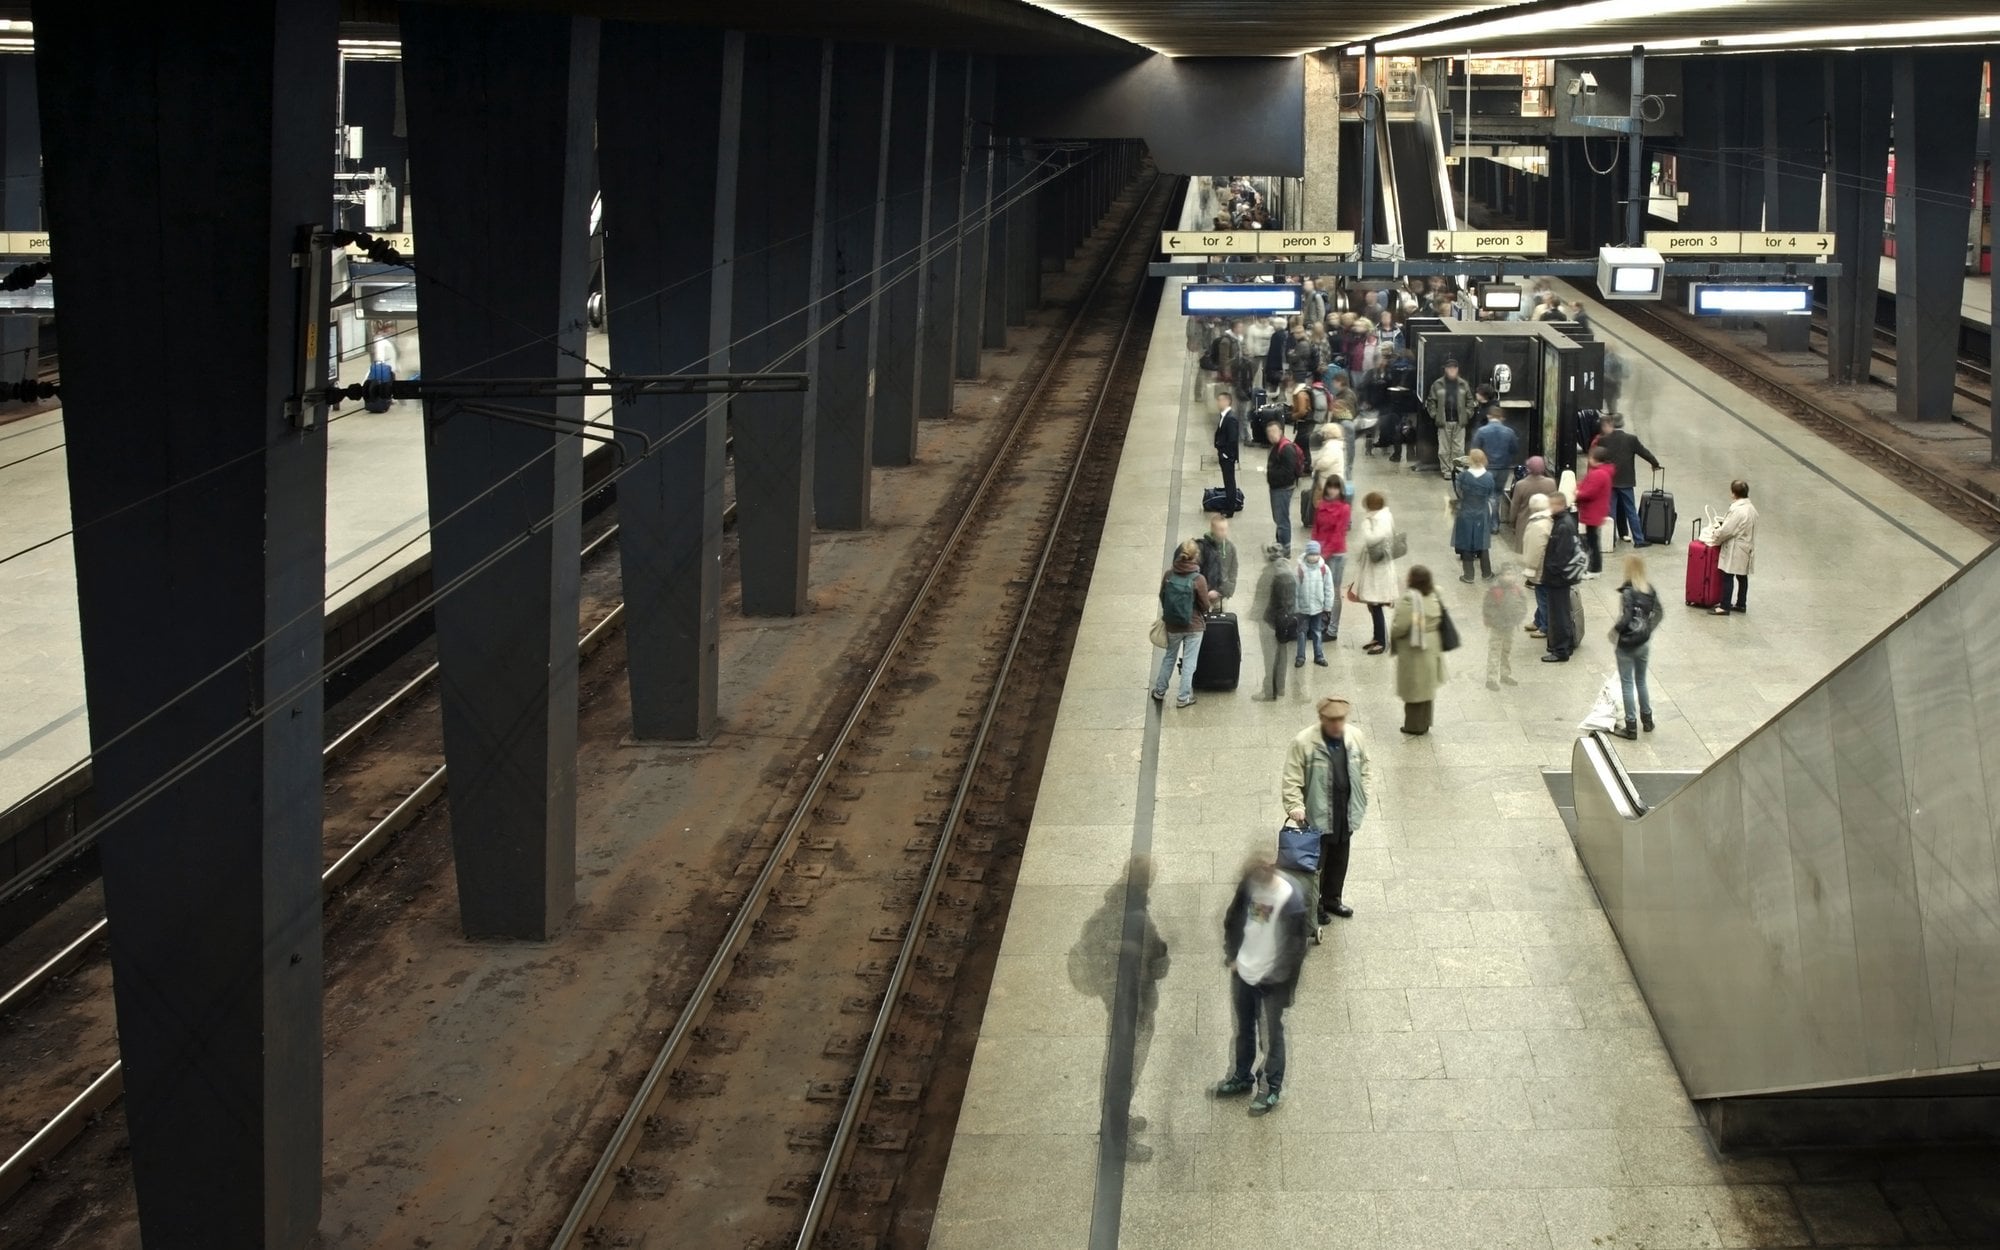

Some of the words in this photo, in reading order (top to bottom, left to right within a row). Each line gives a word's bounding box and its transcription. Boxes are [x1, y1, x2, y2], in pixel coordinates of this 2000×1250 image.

[403, 238, 411, 248] 2
[1203, 236, 1220, 246] tor
[1225, 236, 1233, 246] 2
[1282, 237, 1317, 248] peron
[1323, 236, 1331, 246] 3
[1476, 236, 1510, 248] peron
[1516, 235, 1524, 246] 3
[1670, 237, 1704, 248] peron
[1710, 236, 1718, 247] 3
[1765, 237, 1782, 247] tor
[1788, 237, 1796, 247] 4
